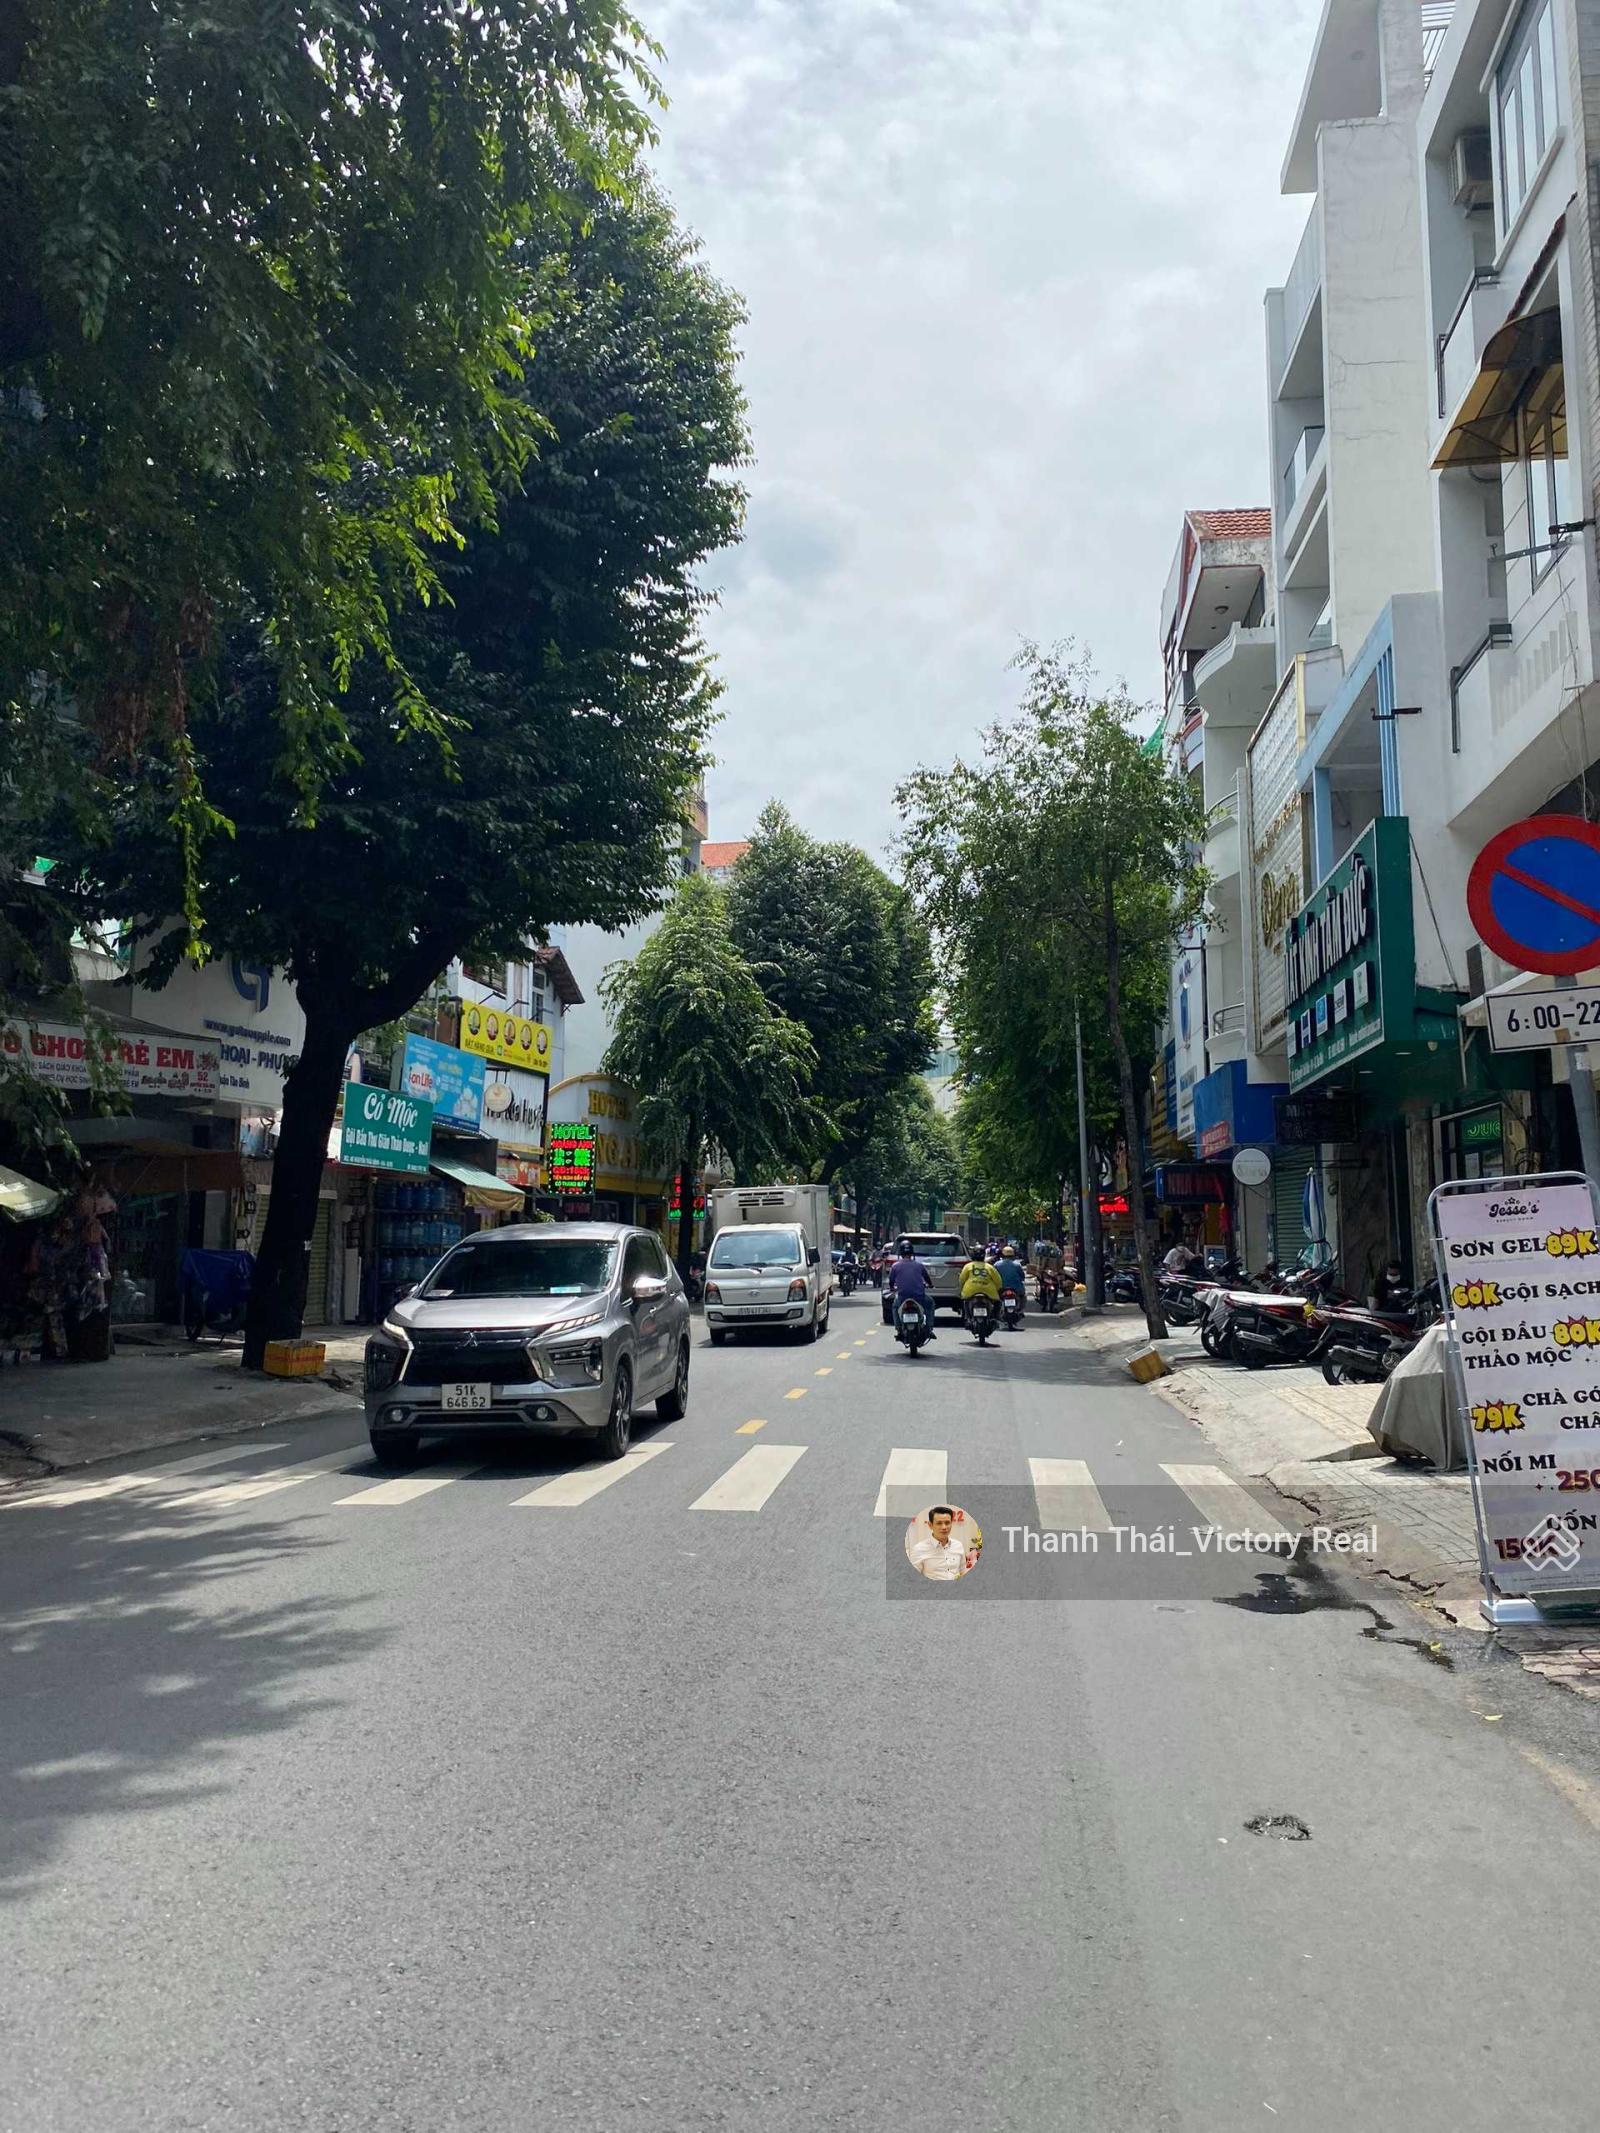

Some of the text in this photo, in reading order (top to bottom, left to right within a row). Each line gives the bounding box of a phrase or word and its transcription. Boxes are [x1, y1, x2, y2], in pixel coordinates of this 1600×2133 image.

[1320, 886, 1343, 974] TÂM
[1343, 853, 1369, 954] ĐỨC
[156, 1046, 195, 1070] EM
[220, 1043, 250, 1068] HOẠI
[197, 1071, 209, 1082] 52
[364, 1092, 386, 1121] Cỏ
[387, 1096, 418, 1132] Mộc
[554, 1126, 592, 1140] HOTEL
[1489, 1201, 1540, 1218] Jesse's
[1450, 1230, 1598, 1259] SƠN GEL 89K
[1452, 1281, 1600, 1309] 60K GỘI SẠCH
[1461, 1326, 1497, 1347] GỘI
[1501, 1320, 1547, 1341] ĐẦU
[1464, 1346, 1573, 1370] THẢO MỘC
[455, 1384, 476, 1396] 51K
[1522, 1388, 1568, 1406] CHÀ
[1471, 1402, 1525, 1431] 79K
[1482, 1450, 1557, 1474] NỐI MI
